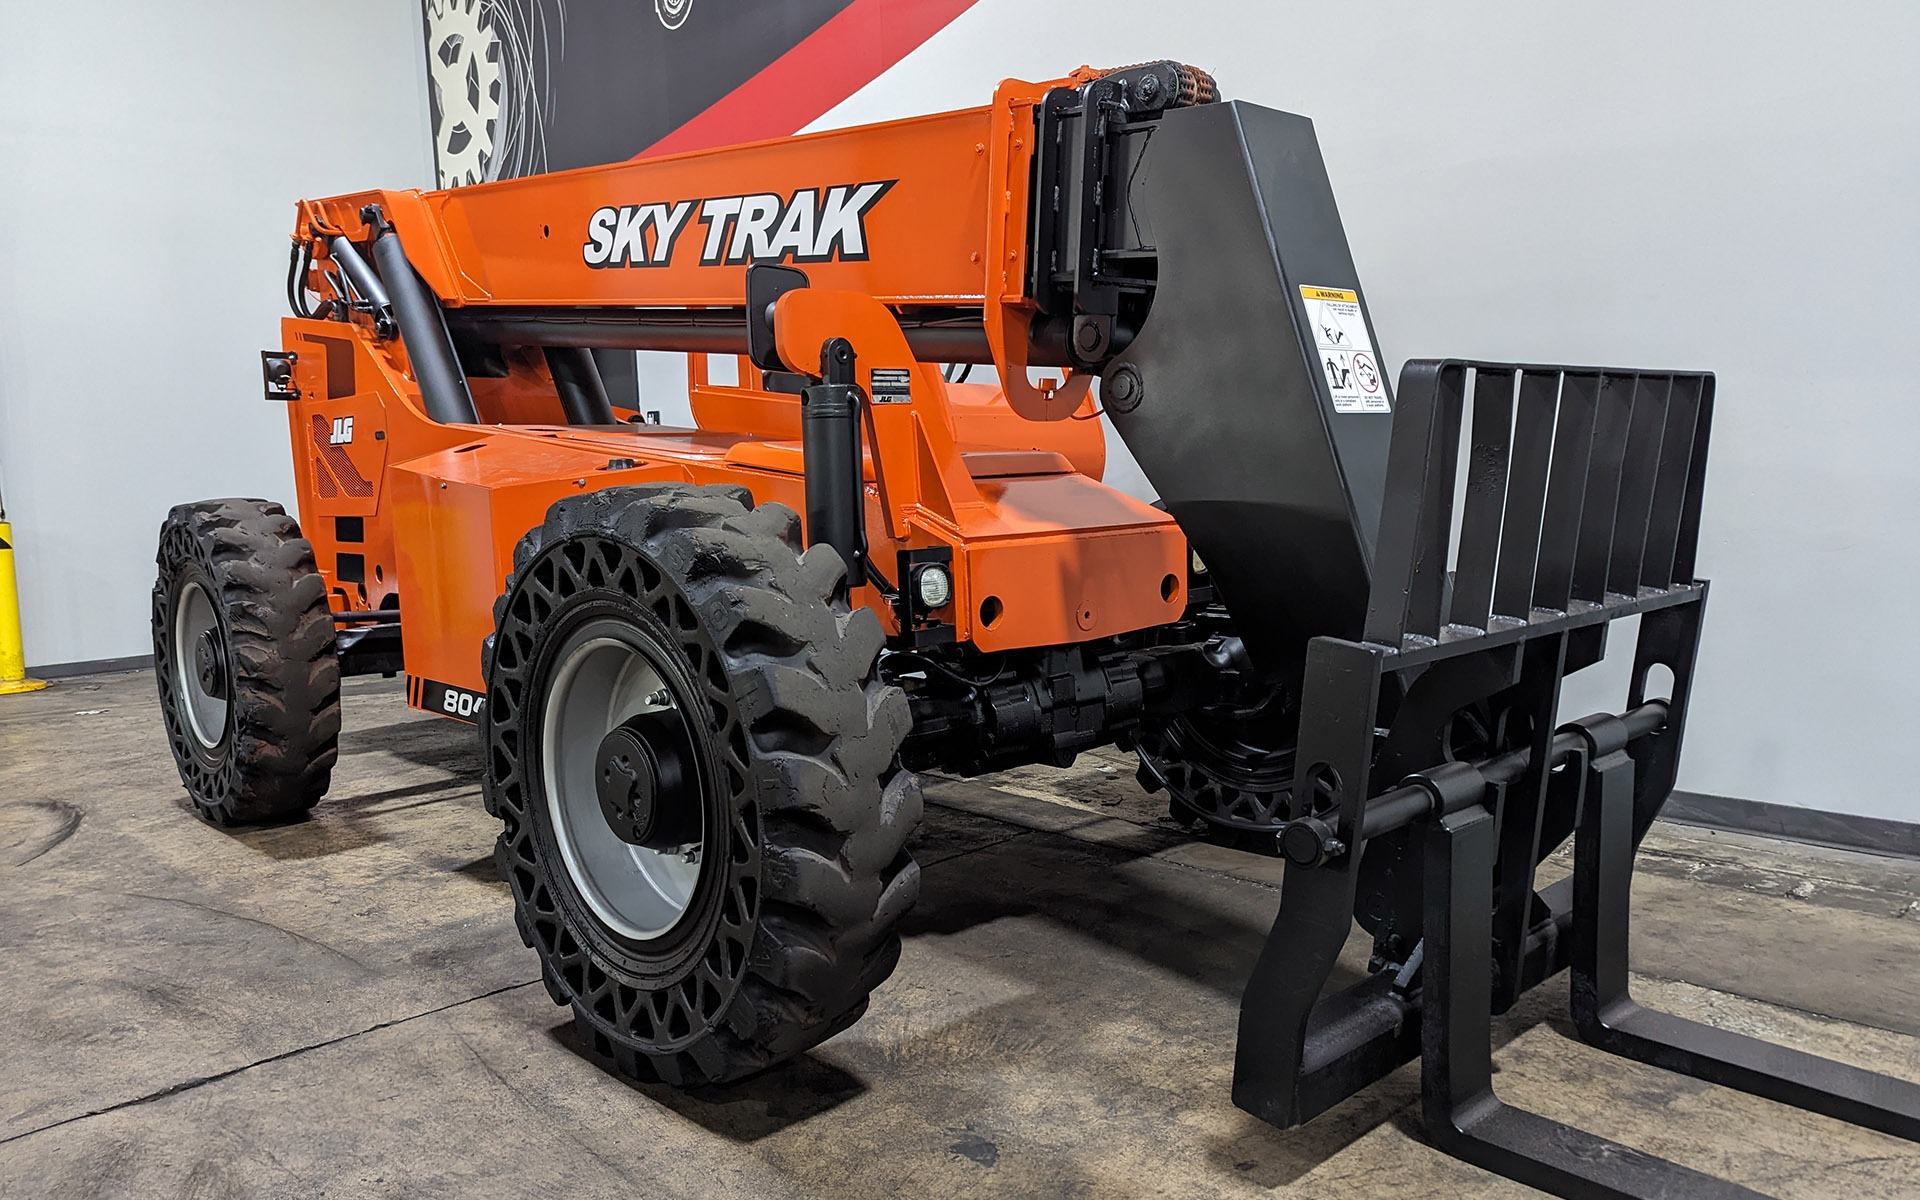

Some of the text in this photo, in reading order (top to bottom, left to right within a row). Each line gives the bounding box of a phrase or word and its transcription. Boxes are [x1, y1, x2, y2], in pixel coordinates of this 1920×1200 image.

[583, 180, 893, 267] SKY TRAK
[1320, 291, 1344, 299] WARNING
[330, 416, 354, 445] JLG
